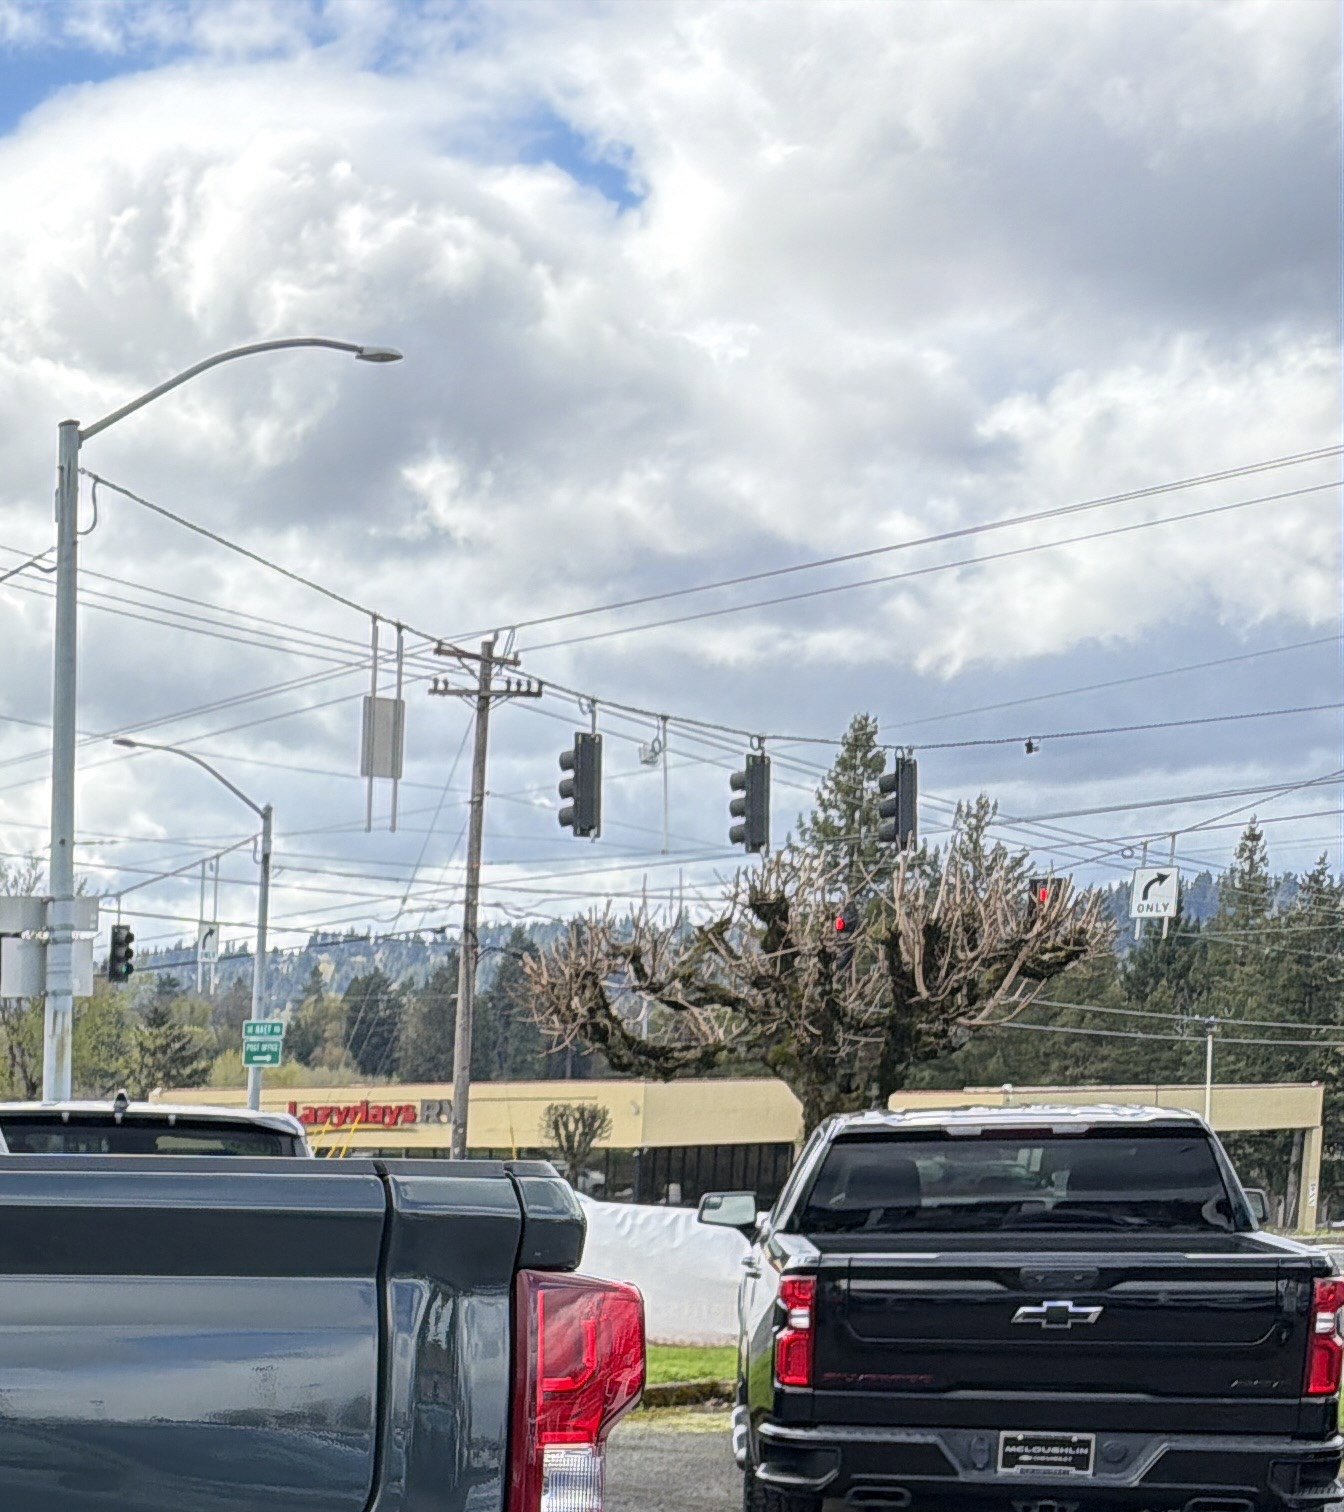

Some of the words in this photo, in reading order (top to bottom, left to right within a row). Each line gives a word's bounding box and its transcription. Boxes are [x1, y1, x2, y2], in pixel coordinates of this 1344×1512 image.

[1137, 903, 1170, 913] ONLY
[288, 1100, 417, 1128] Lazydays
[1005, 1445, 1089, 1455] MCLOUGHLIN
